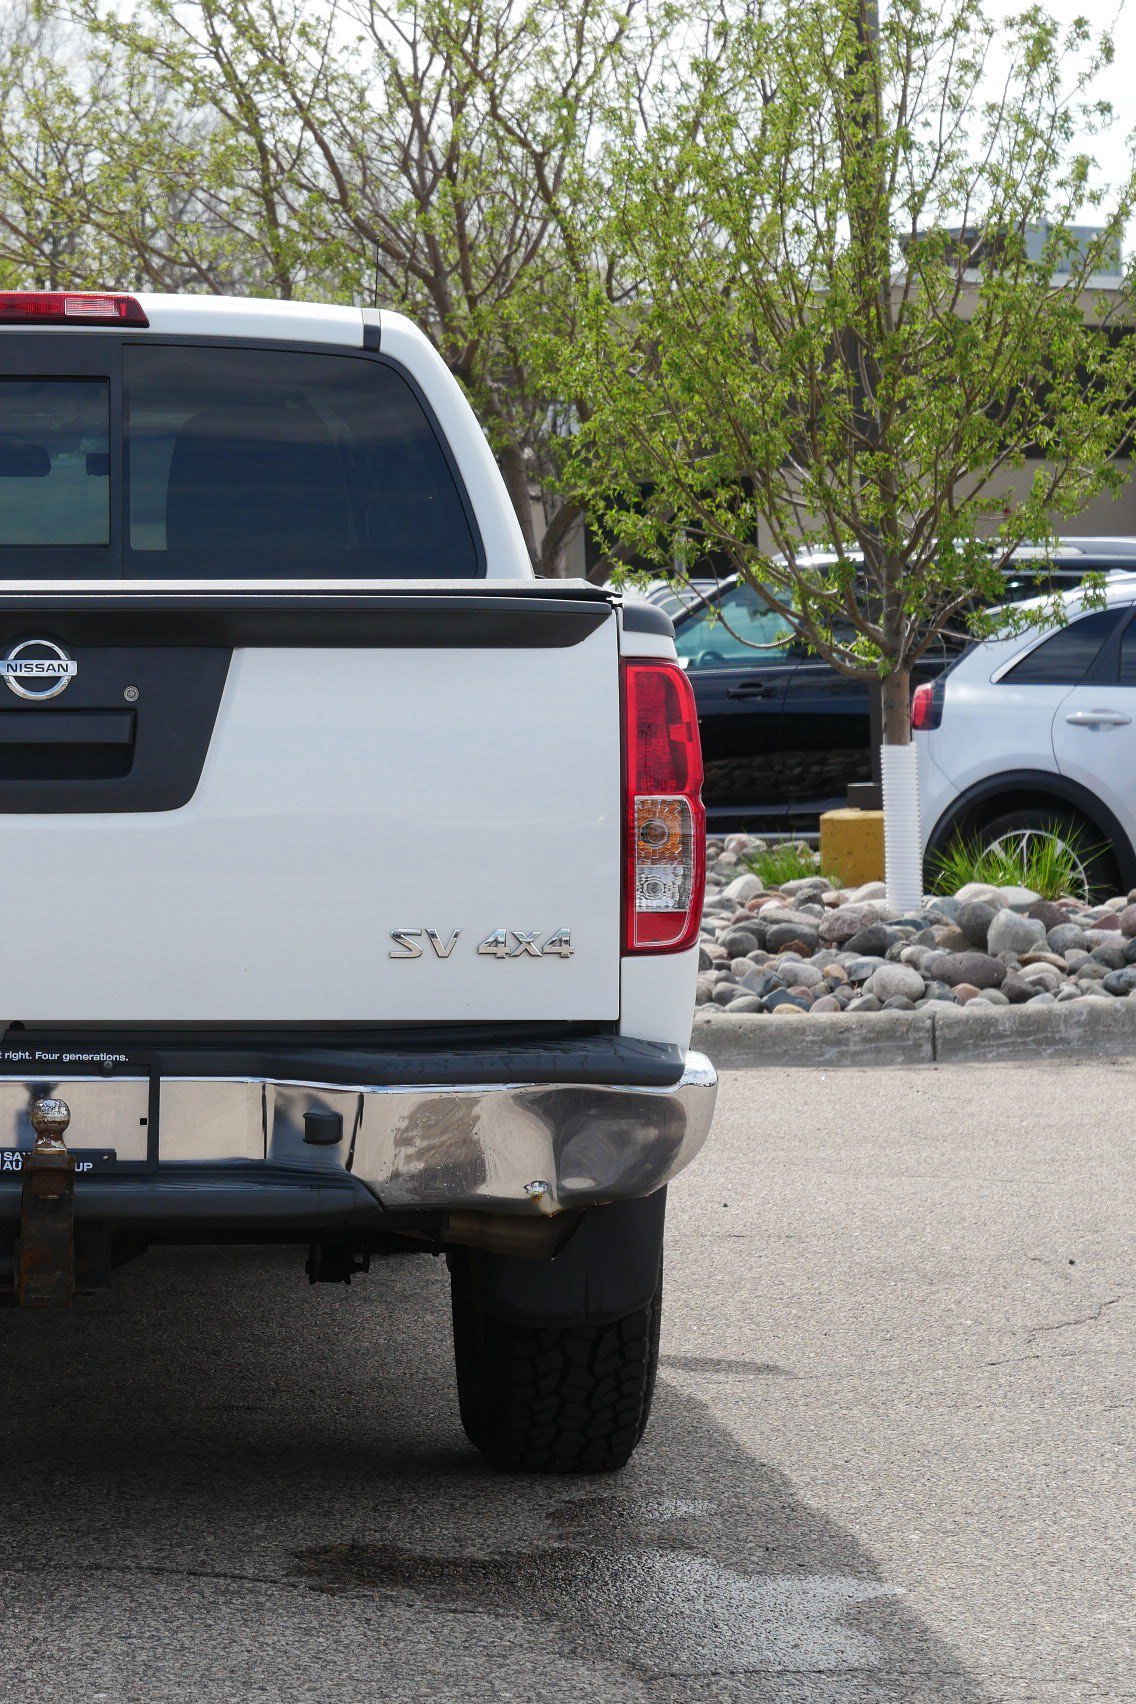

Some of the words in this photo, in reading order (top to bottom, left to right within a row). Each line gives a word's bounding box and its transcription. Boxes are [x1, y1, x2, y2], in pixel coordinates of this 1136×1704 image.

[6, 663, 69, 673] NISSAN
[389, 928, 463, 959] SV
[5, 1052, 33, 1062] right.
[35, 1052, 60, 1061] Four
[63, 1053, 129, 1063] generations.
